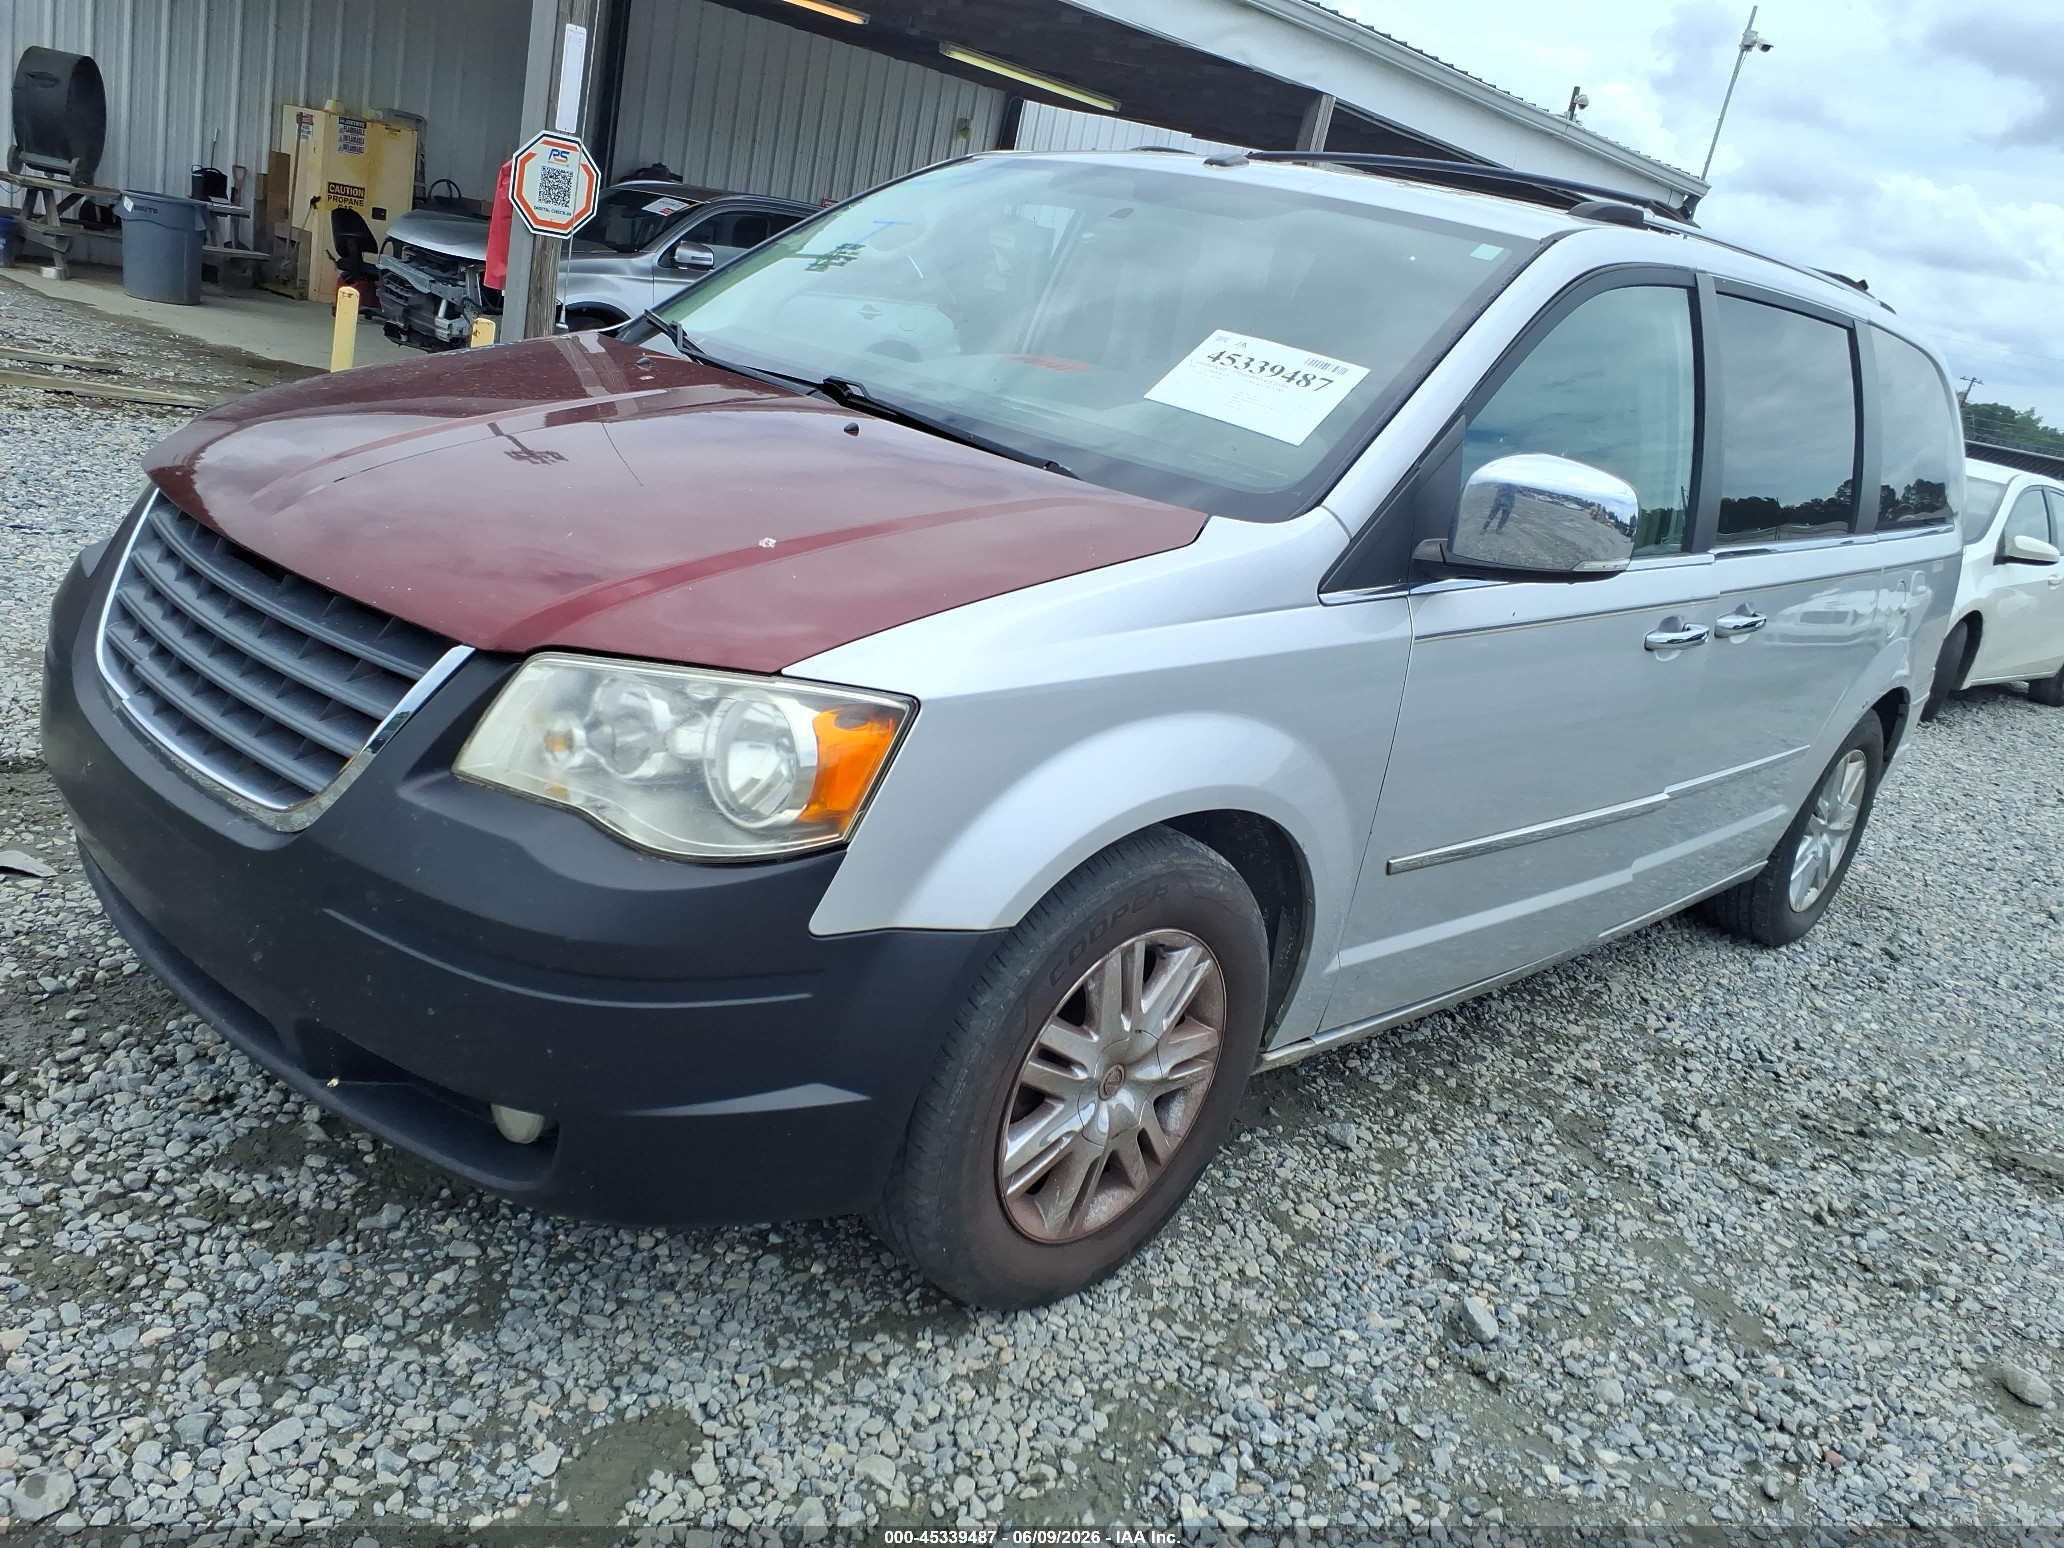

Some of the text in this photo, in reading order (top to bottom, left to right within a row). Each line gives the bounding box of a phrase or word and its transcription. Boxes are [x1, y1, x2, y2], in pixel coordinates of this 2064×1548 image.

[329, 184, 364, 197] CAUTION
[327, 195, 364, 207] PROPANE
[551, 209, 572, 217] CHECK-IN
[1207, 350, 1334, 392] 45339487
[1049, 884, 1169, 987] COOPER
